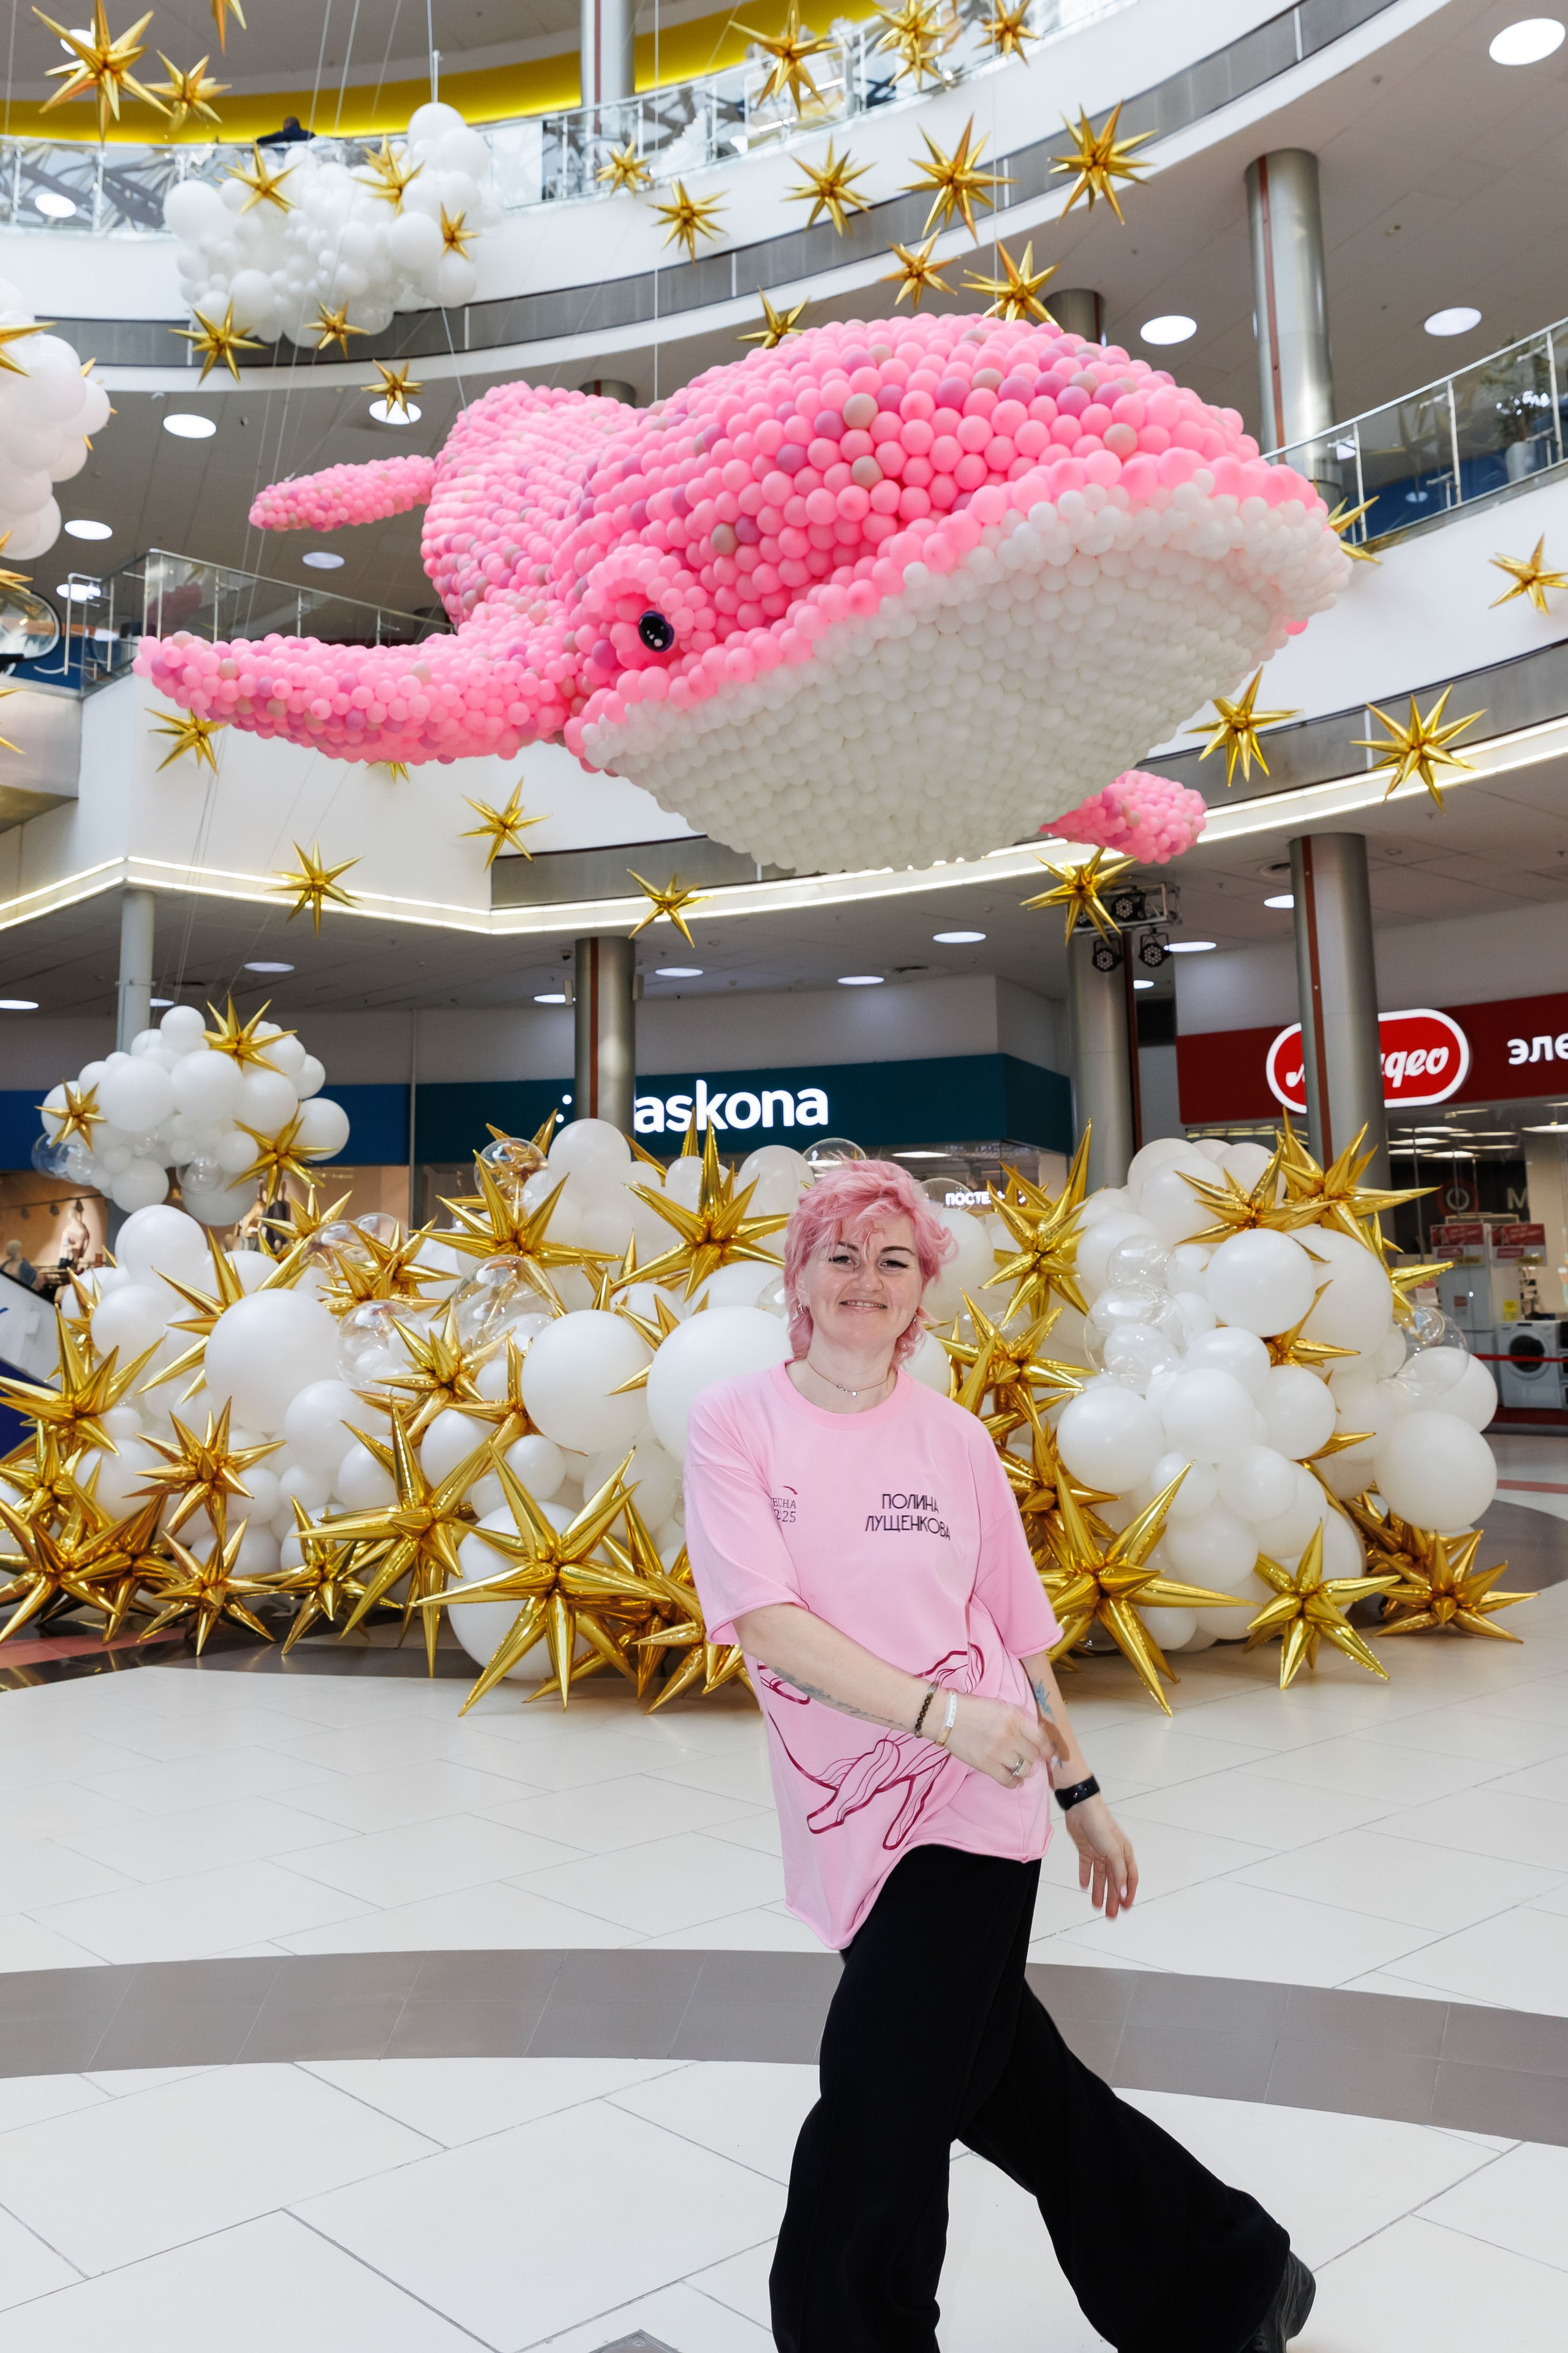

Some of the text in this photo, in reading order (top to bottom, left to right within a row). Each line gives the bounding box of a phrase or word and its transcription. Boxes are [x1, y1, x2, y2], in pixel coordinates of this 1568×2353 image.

[634, 1079, 828, 1133] askona
[772, 1497, 797, 1509] ЕСНА
[882, 1494, 940, 1514] ПОЛИНА
[865, 1515, 951, 1541] ЛУЩЕНКОВА
